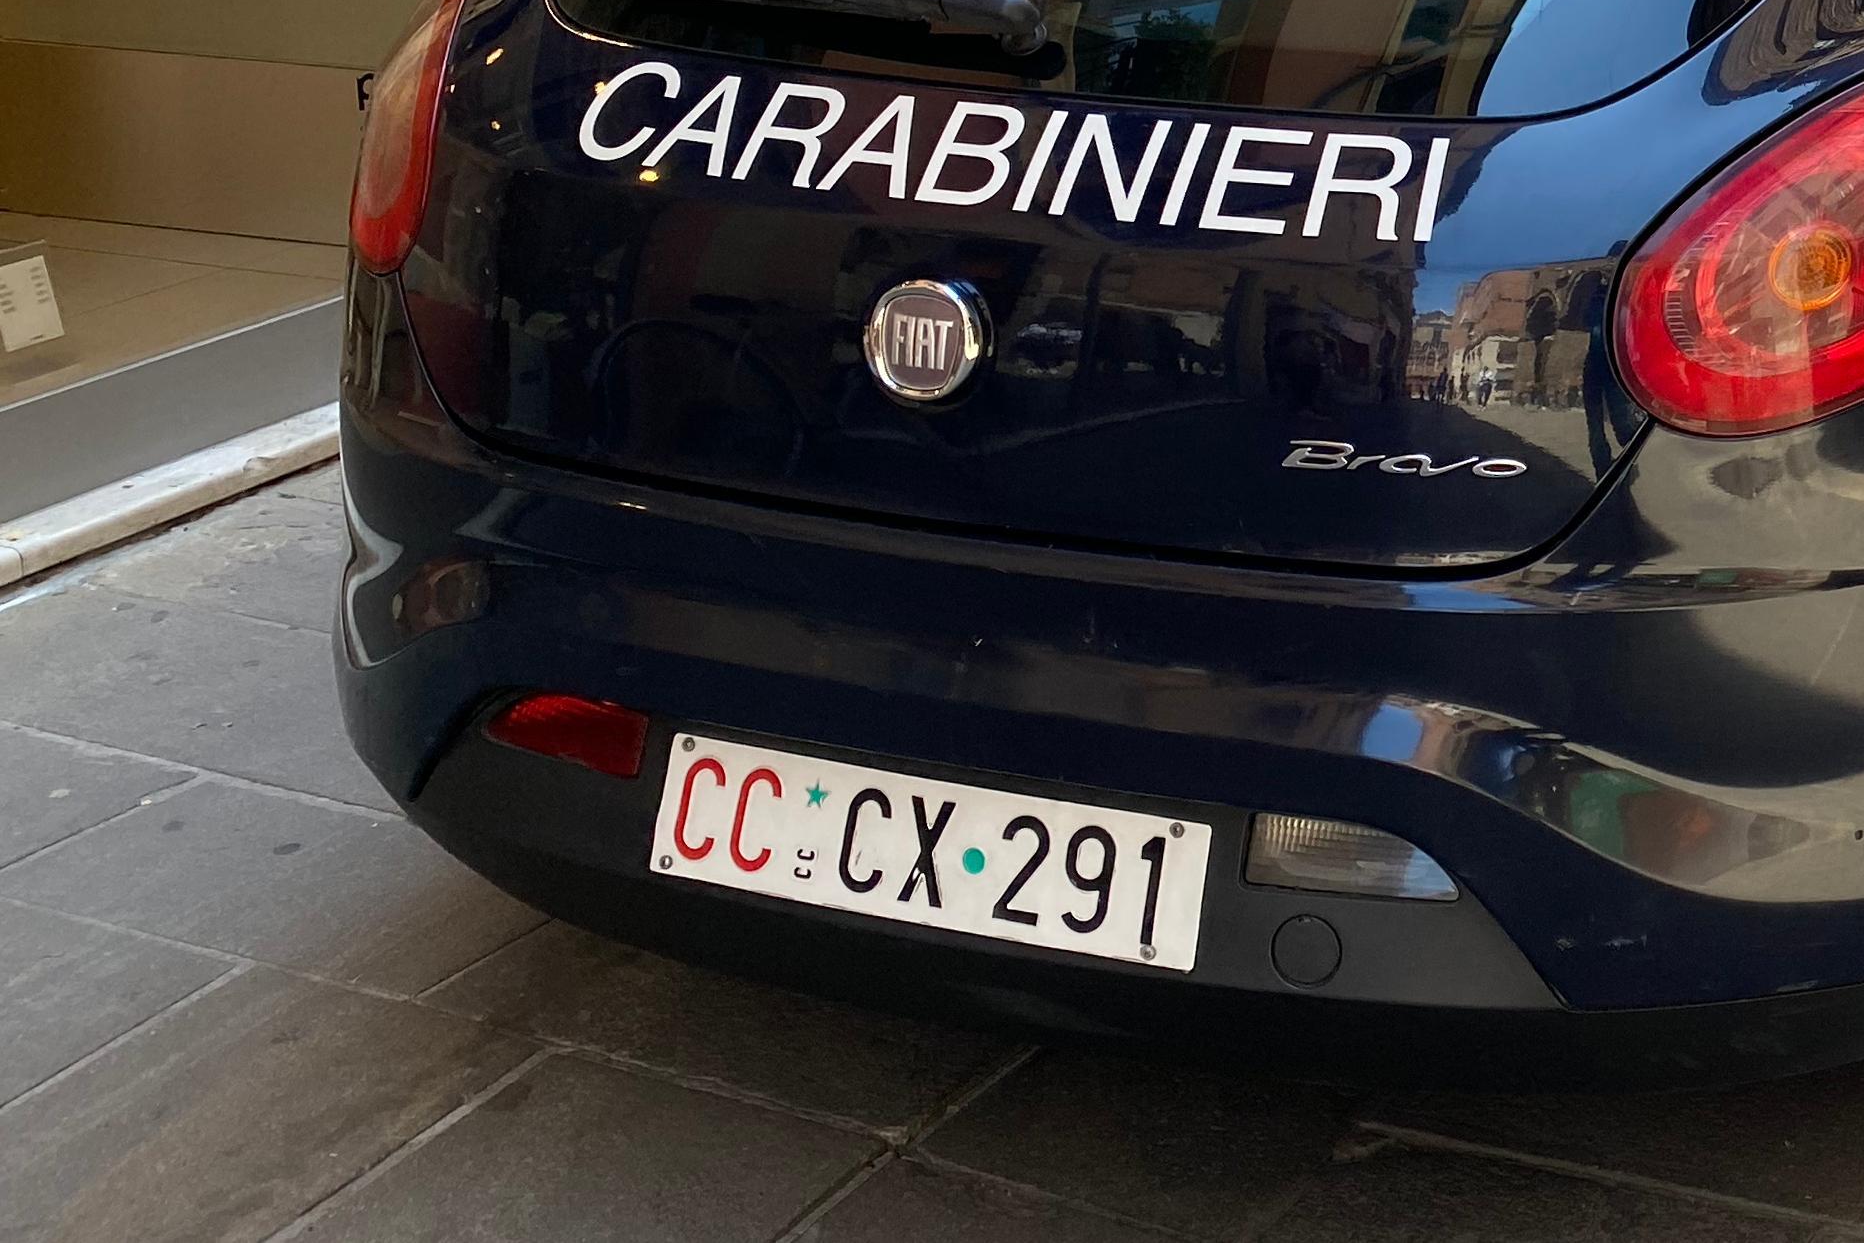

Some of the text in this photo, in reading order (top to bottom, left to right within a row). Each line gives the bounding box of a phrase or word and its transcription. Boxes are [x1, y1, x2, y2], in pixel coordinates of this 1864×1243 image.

[578, 60, 1452, 244] CARABINIERI
[891, 311, 955, 371] FIAT
[1281, 439, 1528, 478] Bravo
[673, 757, 1167, 946] CC CX 291
